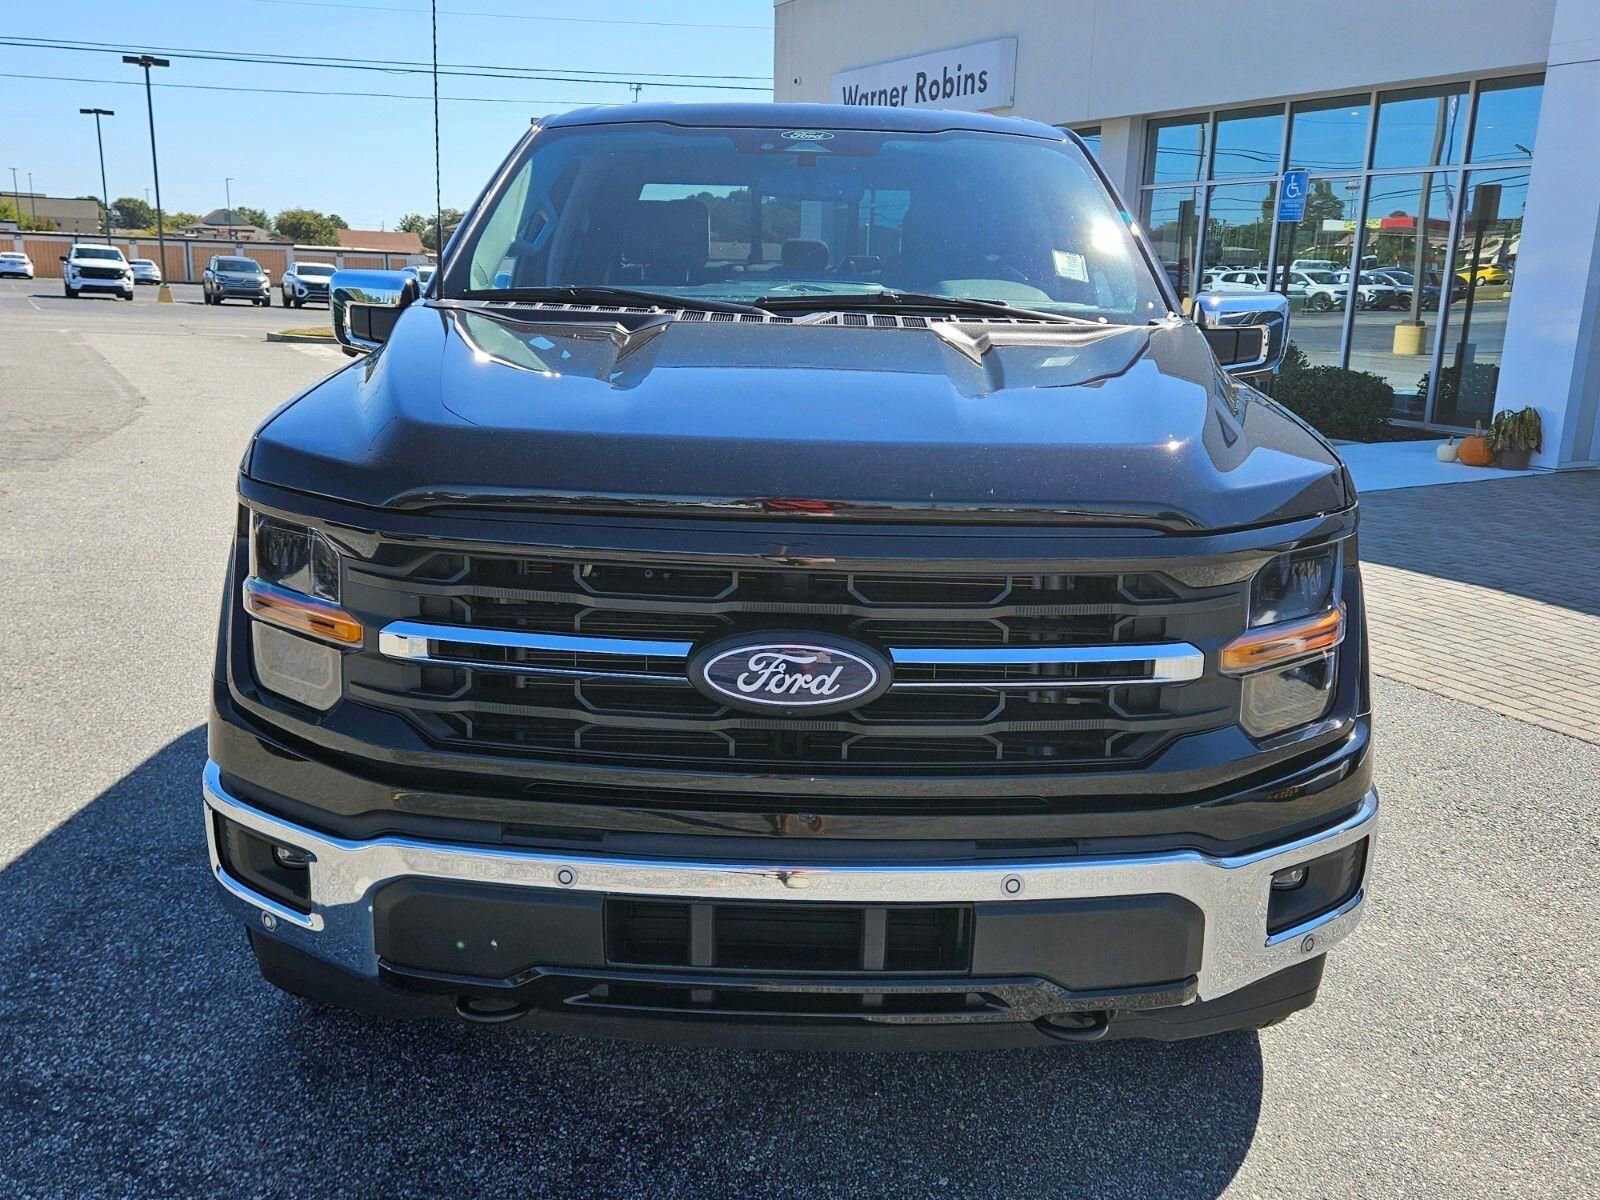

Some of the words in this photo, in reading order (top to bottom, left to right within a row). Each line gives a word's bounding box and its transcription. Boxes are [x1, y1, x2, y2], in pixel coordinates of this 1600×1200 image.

[842, 83, 908, 107] Warner
[914, 63, 988, 103] Robins
[736, 652, 844, 696] Ford
